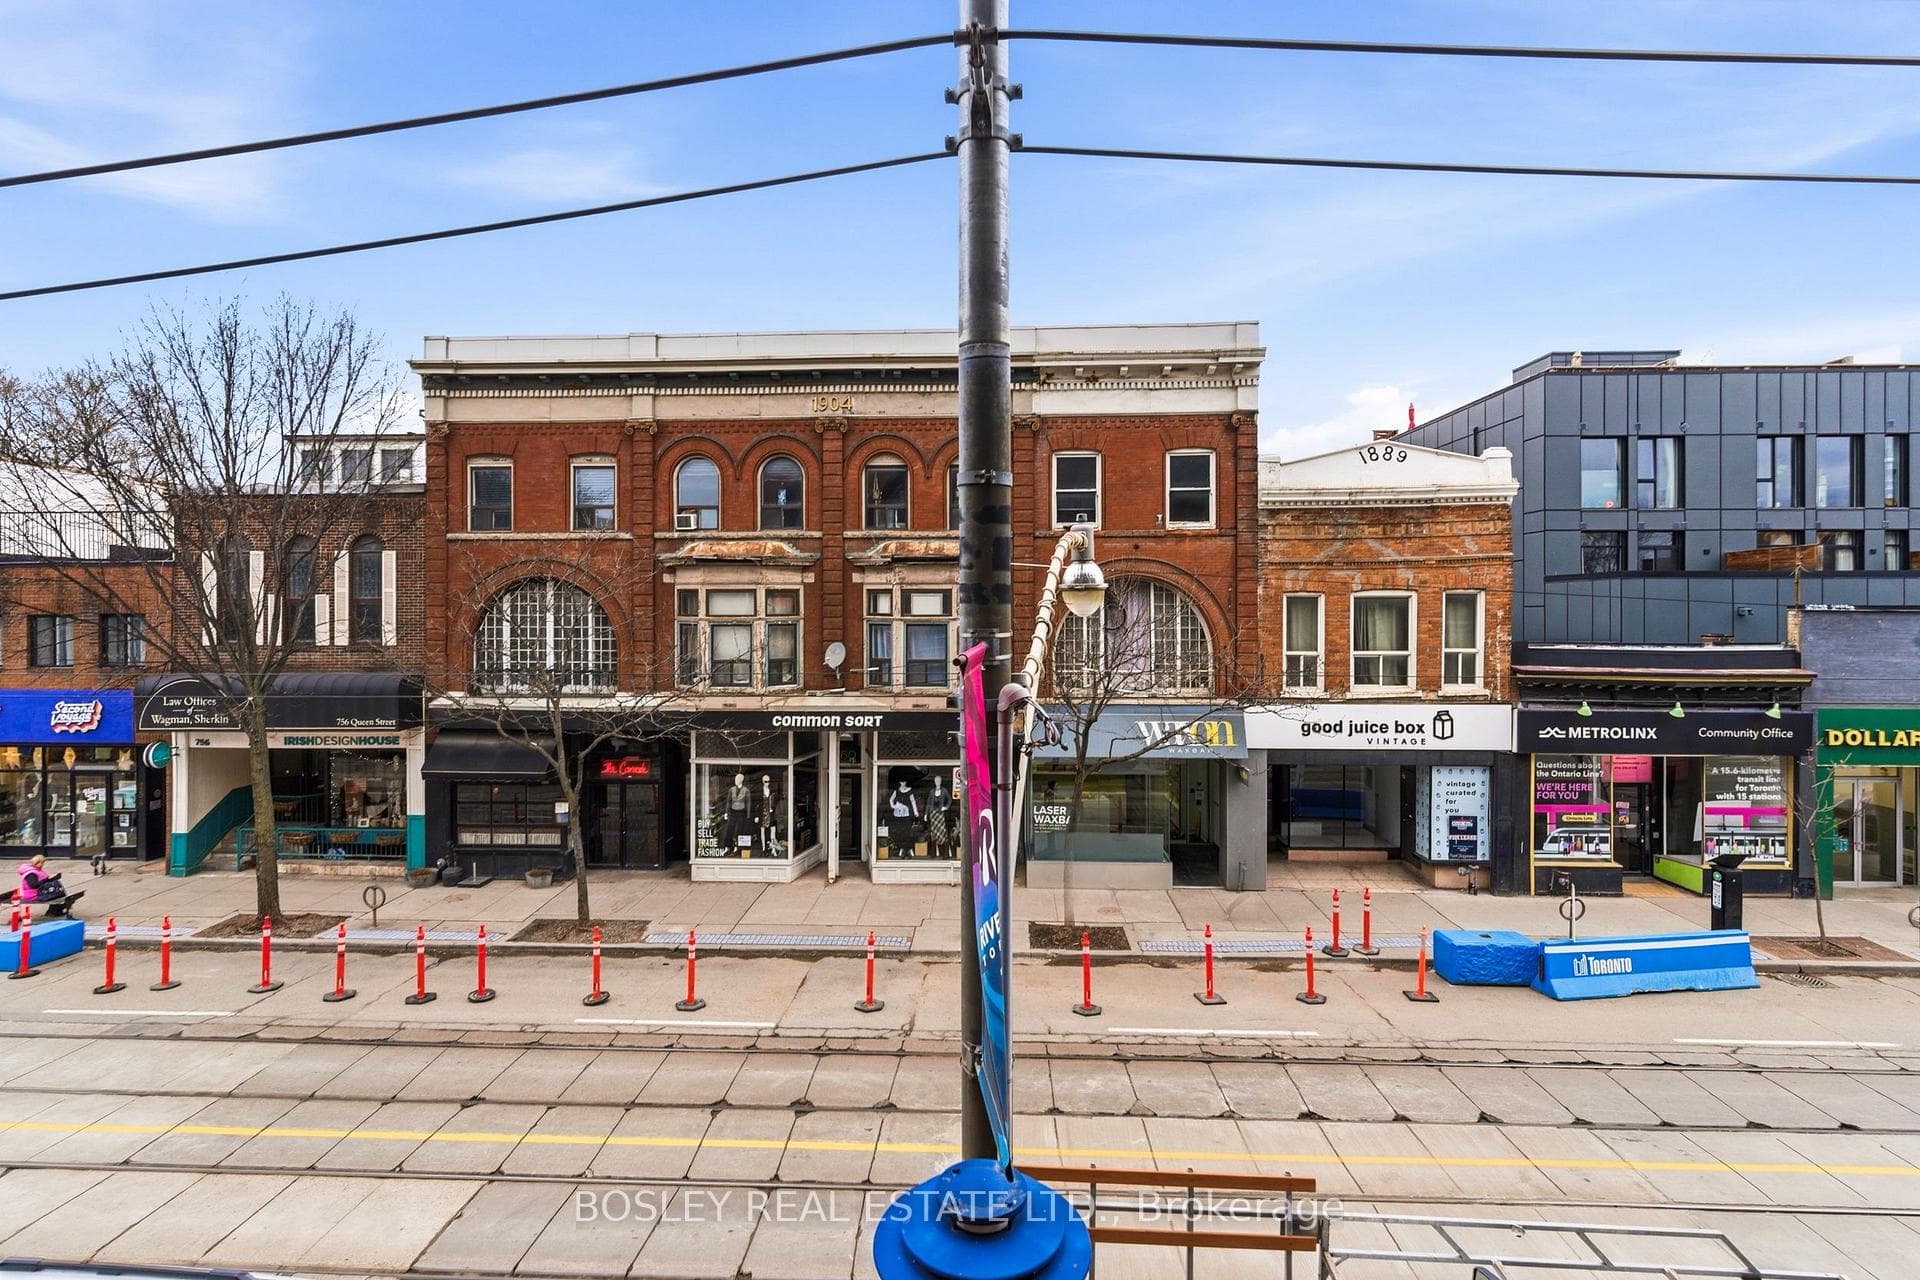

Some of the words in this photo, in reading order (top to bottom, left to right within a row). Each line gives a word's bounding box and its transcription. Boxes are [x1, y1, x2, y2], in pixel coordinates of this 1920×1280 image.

[812, 395, 853, 412] 1904
[1359, 446, 1407, 464] 1889
[163, 696, 181, 706] Law
[184, 696, 217, 706] Offices
[51, 700, 98, 714] Second
[50, 712, 93, 726] Voyage
[151, 715, 193, 726] Wagman,
[336, 718, 349, 726] 756
[350, 718, 374, 727] Queen
[375, 718, 396, 726] Street
[845, 715, 883, 727] SORT
[1301, 720, 1343, 737] good
[1348, 720, 1389, 737] juice
[1394, 720, 1425, 734] box
[1568, 727, 1657, 739] METROLINX
[1698, 727, 1759, 740] Community
[1761, 727, 1794, 738] Office
[195, 738, 210, 746] 756
[284, 736, 400, 746] IRISHDESIGNHOUSE
[1367, 738, 1427, 746] VINTAGE
[1536, 762, 1576, 770] Questions
[1551, 770, 1581, 778] Ontario
[1583, 770, 1604, 778] Line?
[1737, 775, 1764, 783] transit
[1536, 783, 1567, 791] WE'RE
[1568, 783, 1593, 791] HERE
[1536, 791, 1556, 800] FOR
[1557, 791, 1579, 800] YOU
[1716, 792, 1735, 800] with
[1737, 792, 1747, 800] 15
[1749, 792, 1781, 800] stations
[1033, 805, 1067, 815] LASER
[697, 819, 711, 828] BUY
[697, 829, 713, 838] SELL
[698, 838, 718, 847] TRADE
[697, 848, 725, 856] FASHION
[1588, 956, 1632, 975] TORONTO
